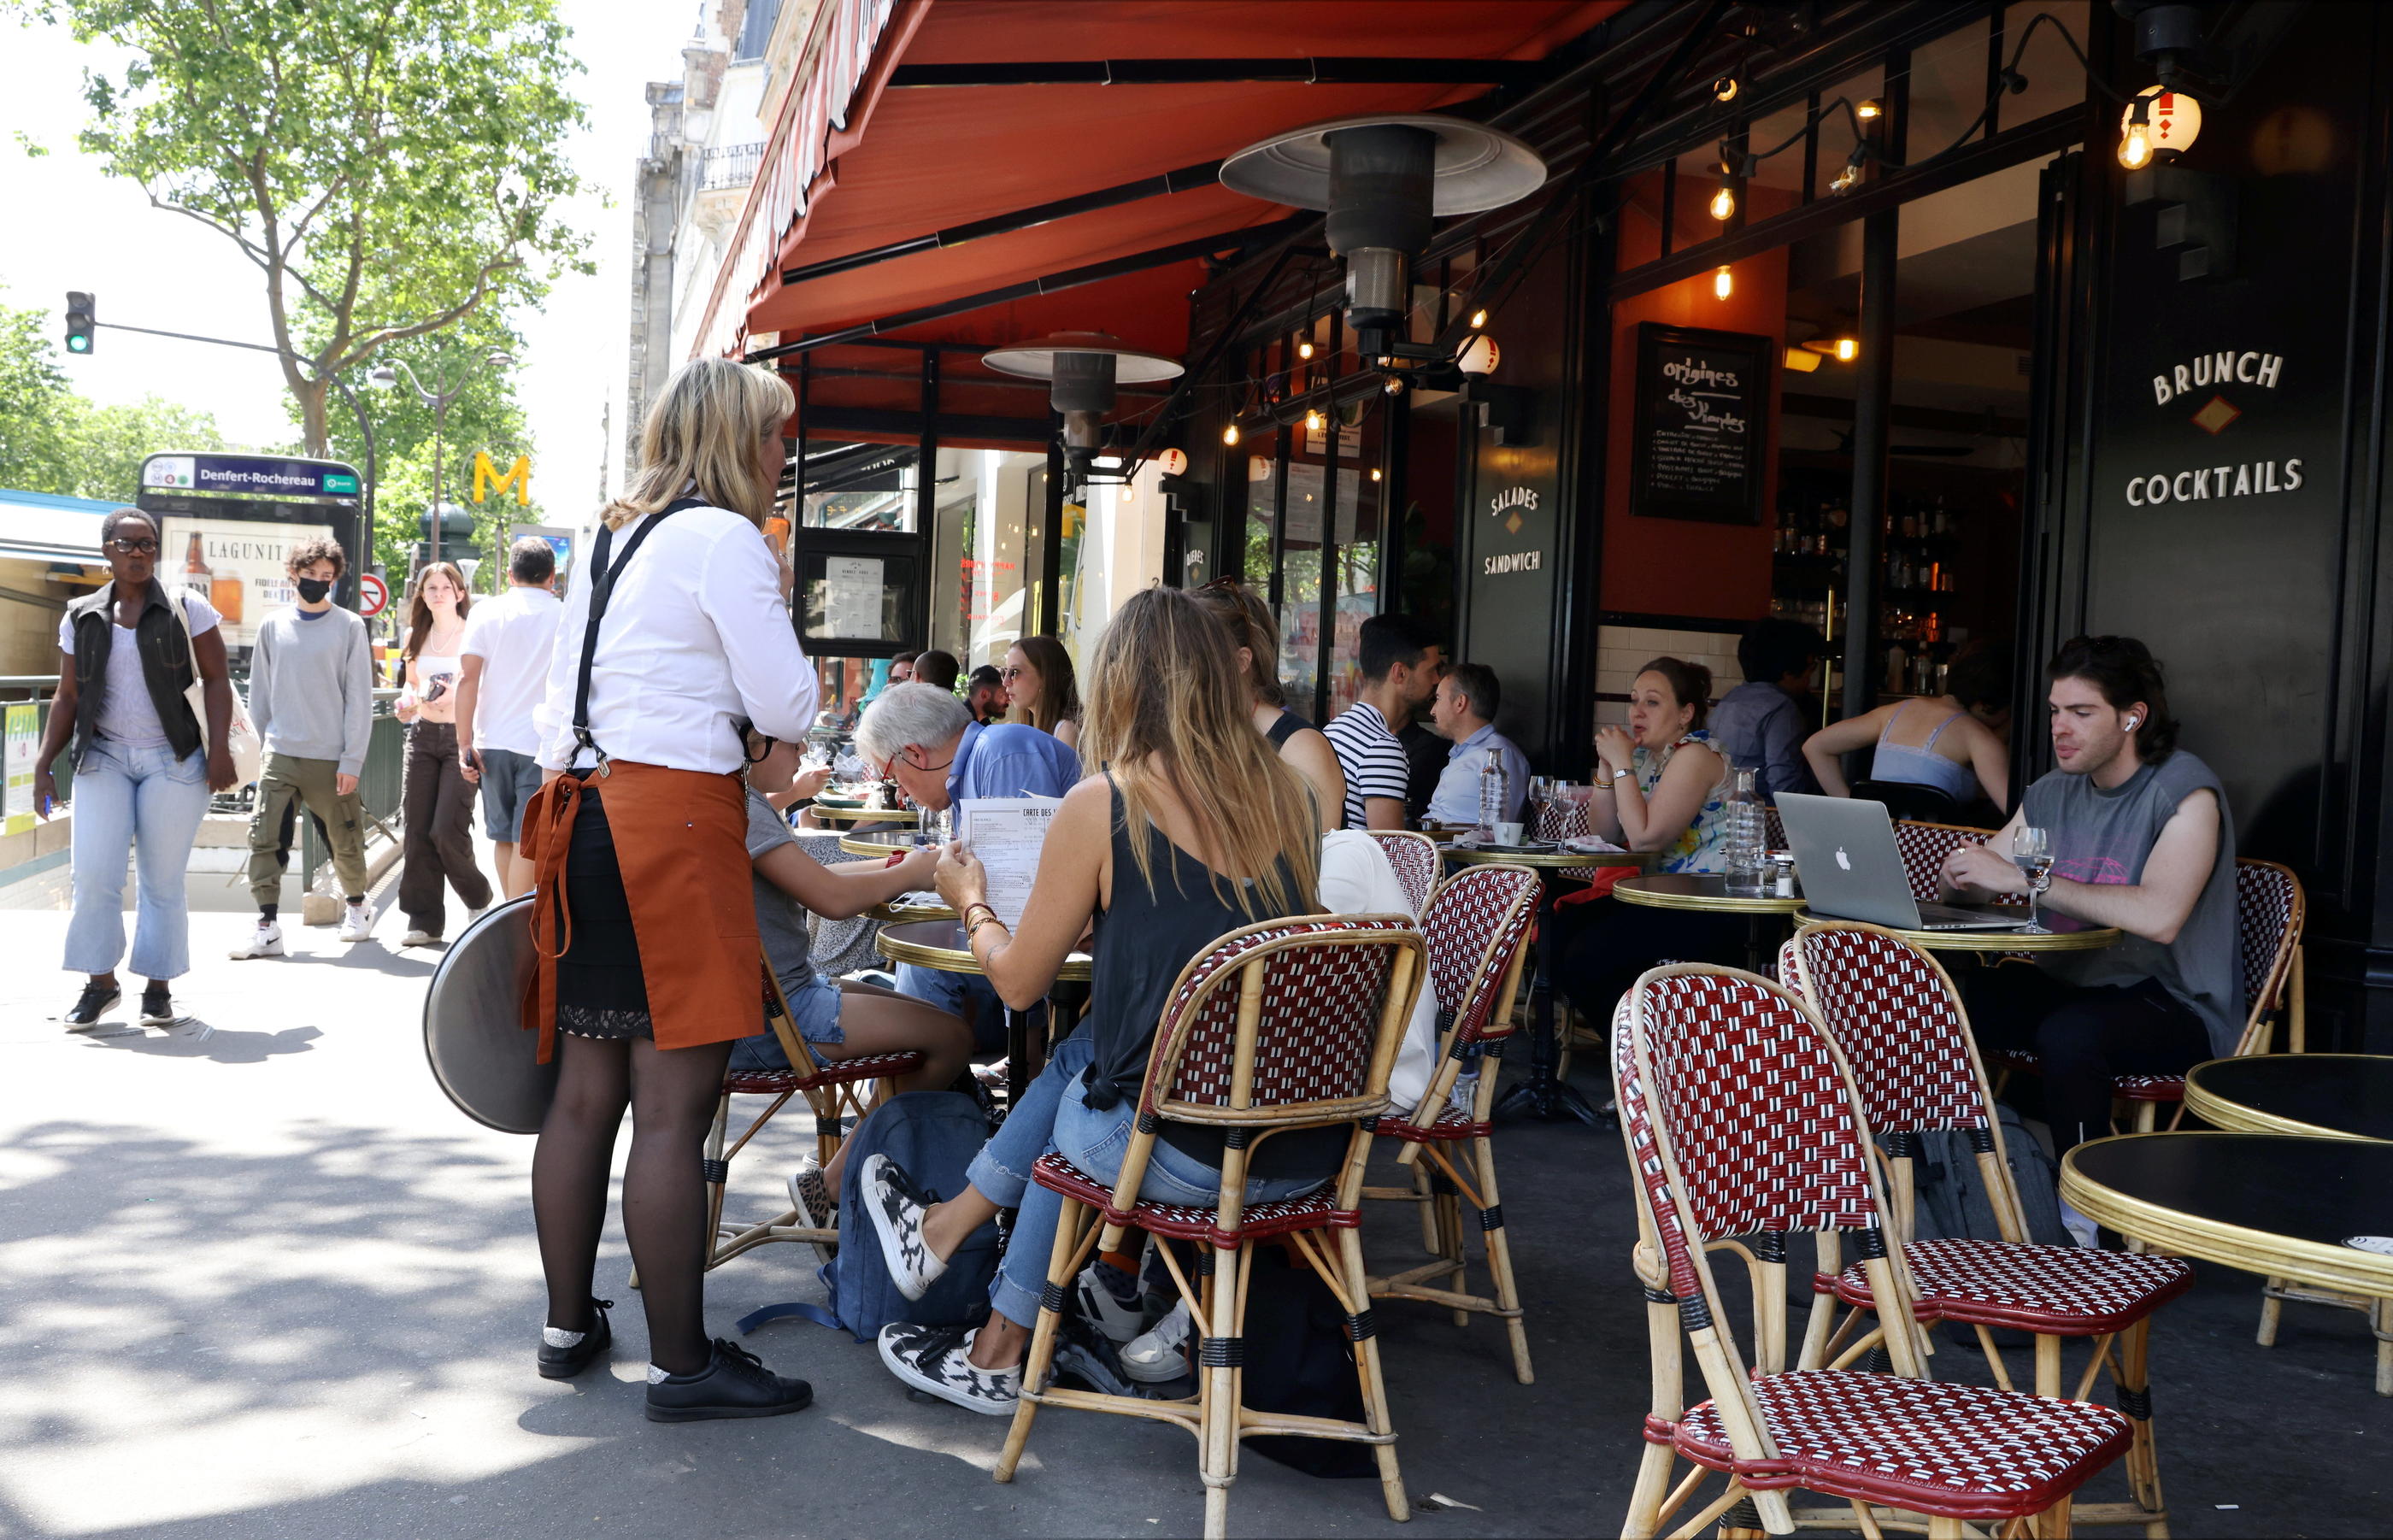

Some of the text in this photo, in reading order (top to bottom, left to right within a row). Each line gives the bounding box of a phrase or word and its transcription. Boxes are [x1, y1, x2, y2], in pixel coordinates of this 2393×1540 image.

[2153, 350, 2284, 406] BRUNCH
[1668, 388, 1696, 408] des
[200, 469, 315, 487] Denfert-Rochereau
[473, 451, 530, 506] M
[2126, 458, 2303, 506] COCKTAILS
[1491, 486, 1539, 516] SALADES
[209, 541, 292, 561] LAGUNIT
[1485, 550, 1541, 574] SANDWICH
[1023, 808, 1039, 817] CARTE
[1041, 808, 1052, 817] DES
